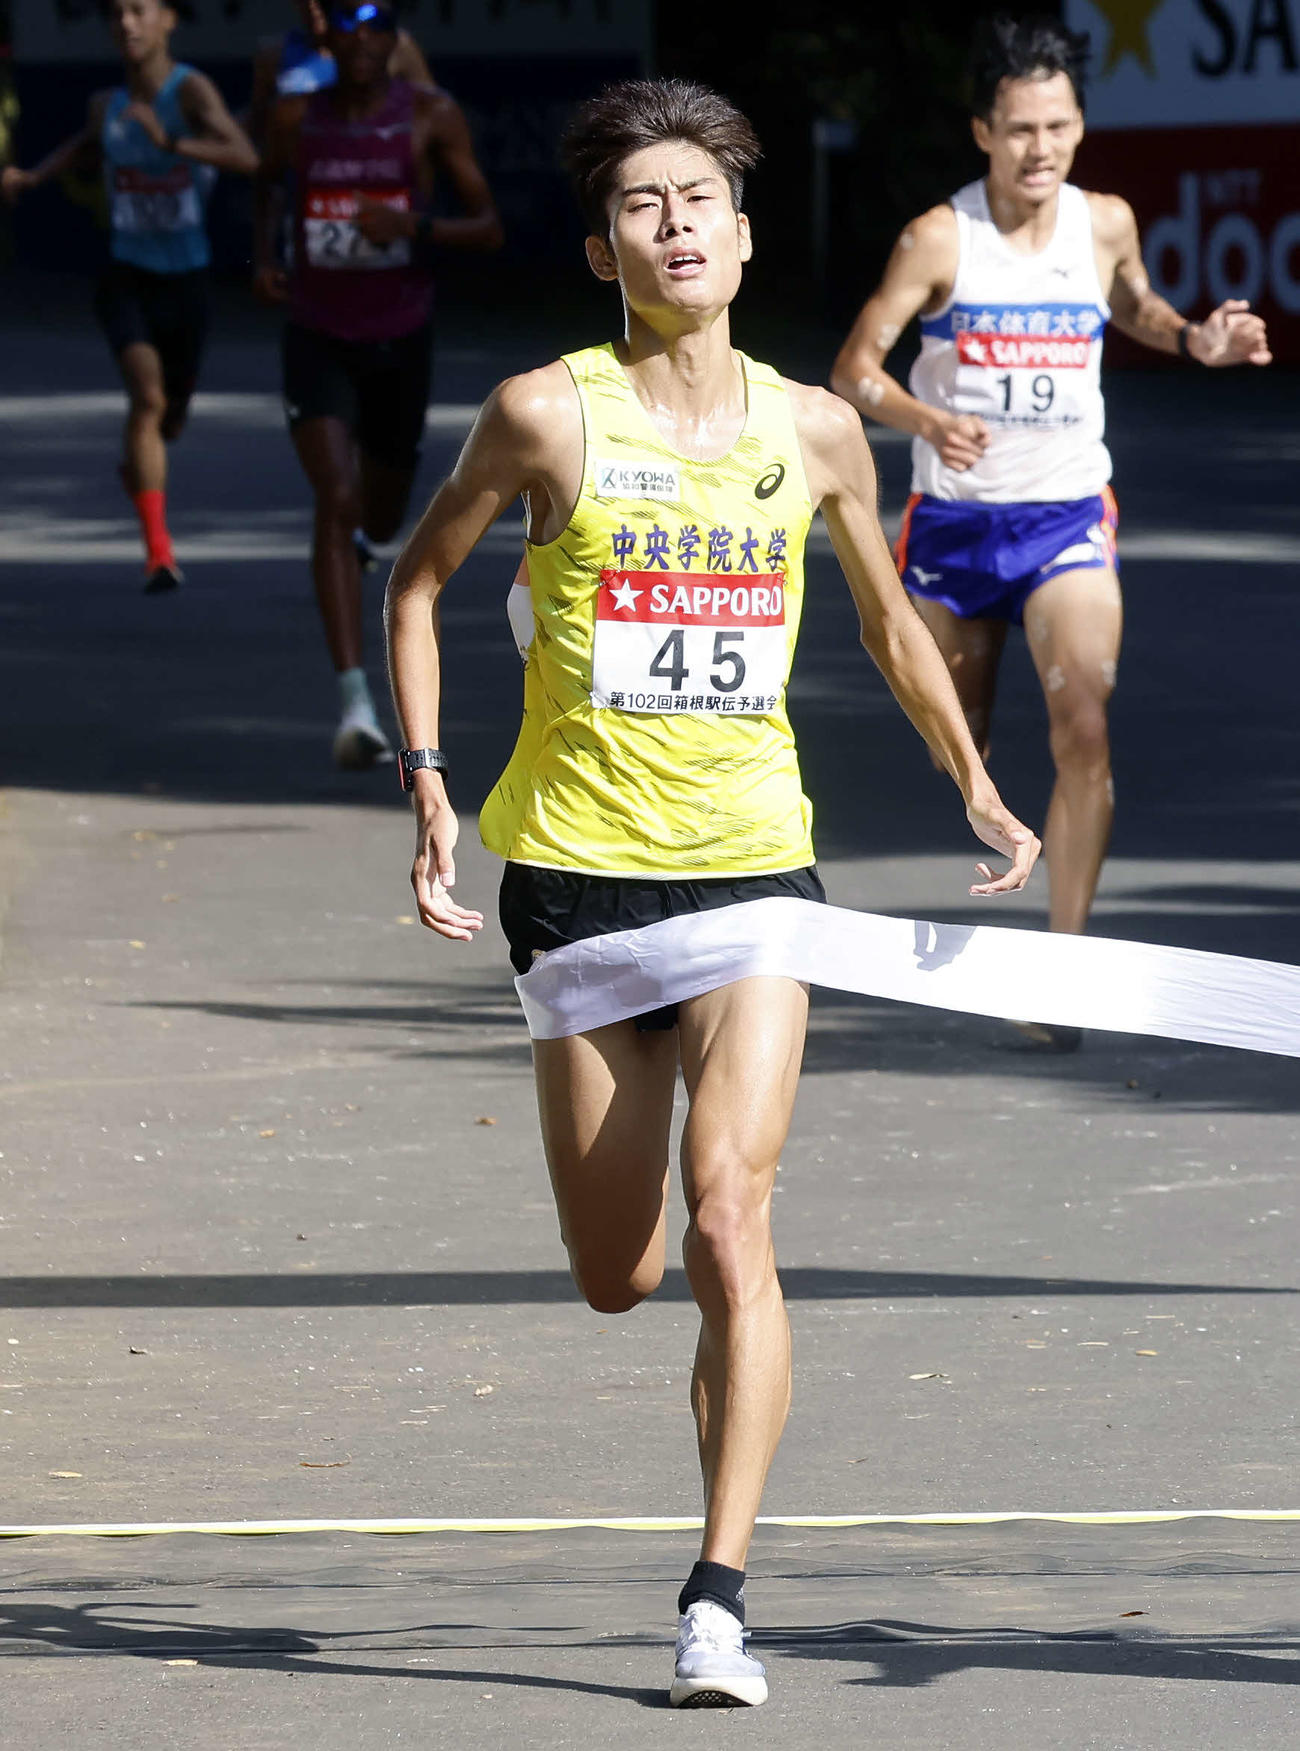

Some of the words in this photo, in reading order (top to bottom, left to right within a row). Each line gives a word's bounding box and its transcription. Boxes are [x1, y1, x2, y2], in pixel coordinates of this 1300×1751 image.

[951, 311, 1100, 338] 日本体育大学
[992, 342, 1088, 366] SAPPORO
[996, 374, 1055, 411] 19
[619, 470, 676, 486] KYOWA
[612, 524, 787, 572] 中央学院大学
[649, 585, 783, 616] SAPPORO
[649, 629, 746, 692] 45
[610, 691, 776, 711] 第102回箱根駅伝予選会
